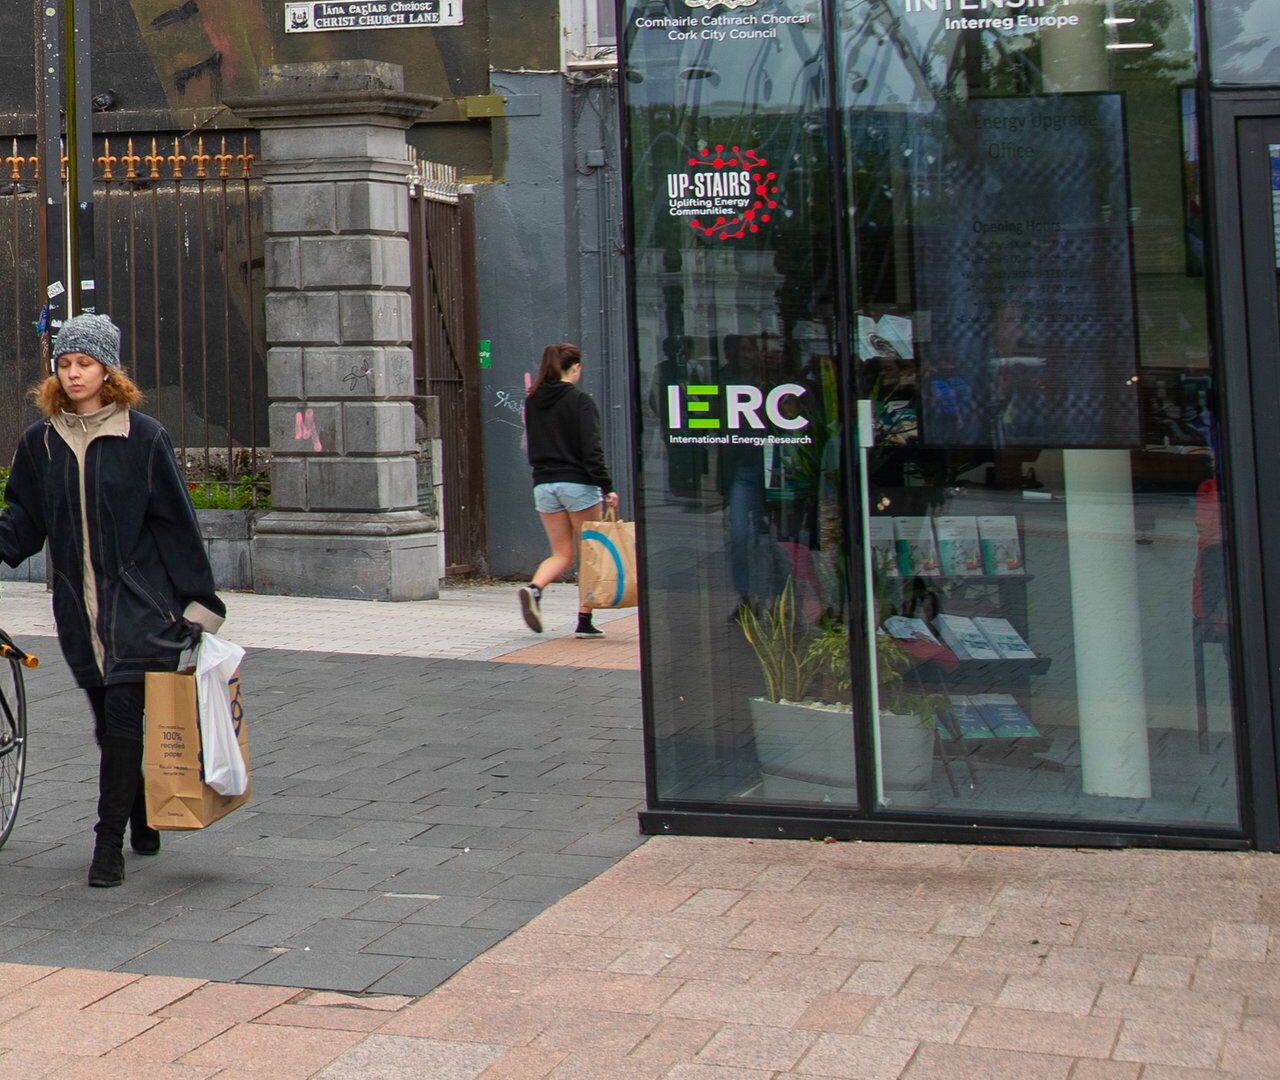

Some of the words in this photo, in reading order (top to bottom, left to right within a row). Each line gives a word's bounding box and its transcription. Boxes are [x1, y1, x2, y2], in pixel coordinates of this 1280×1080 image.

[315, 16, 355, 27] CHRIST
[358, 14, 404, 25] CHURCH
[409, 12, 439, 23] LANE
[635, 16, 698, 28] Comhairle
[701, 14, 758, 26] Cathrach
[945, 16, 1014, 31] Interreg
[1017, 14, 1079, 28] Europe
[668, 29, 697, 41] Cork
[701, 29, 726, 41] City
[729, 28, 776, 39] Council
[667, 171, 751, 198] UP-STAIRS
[669, 198, 712, 208] Uplifting
[714, 197, 750, 207] Energy
[667, 383, 809, 430] IERC
[669, 435, 729, 444] International
[731, 435, 766, 446] Energy
[767, 434, 812, 444] Research
